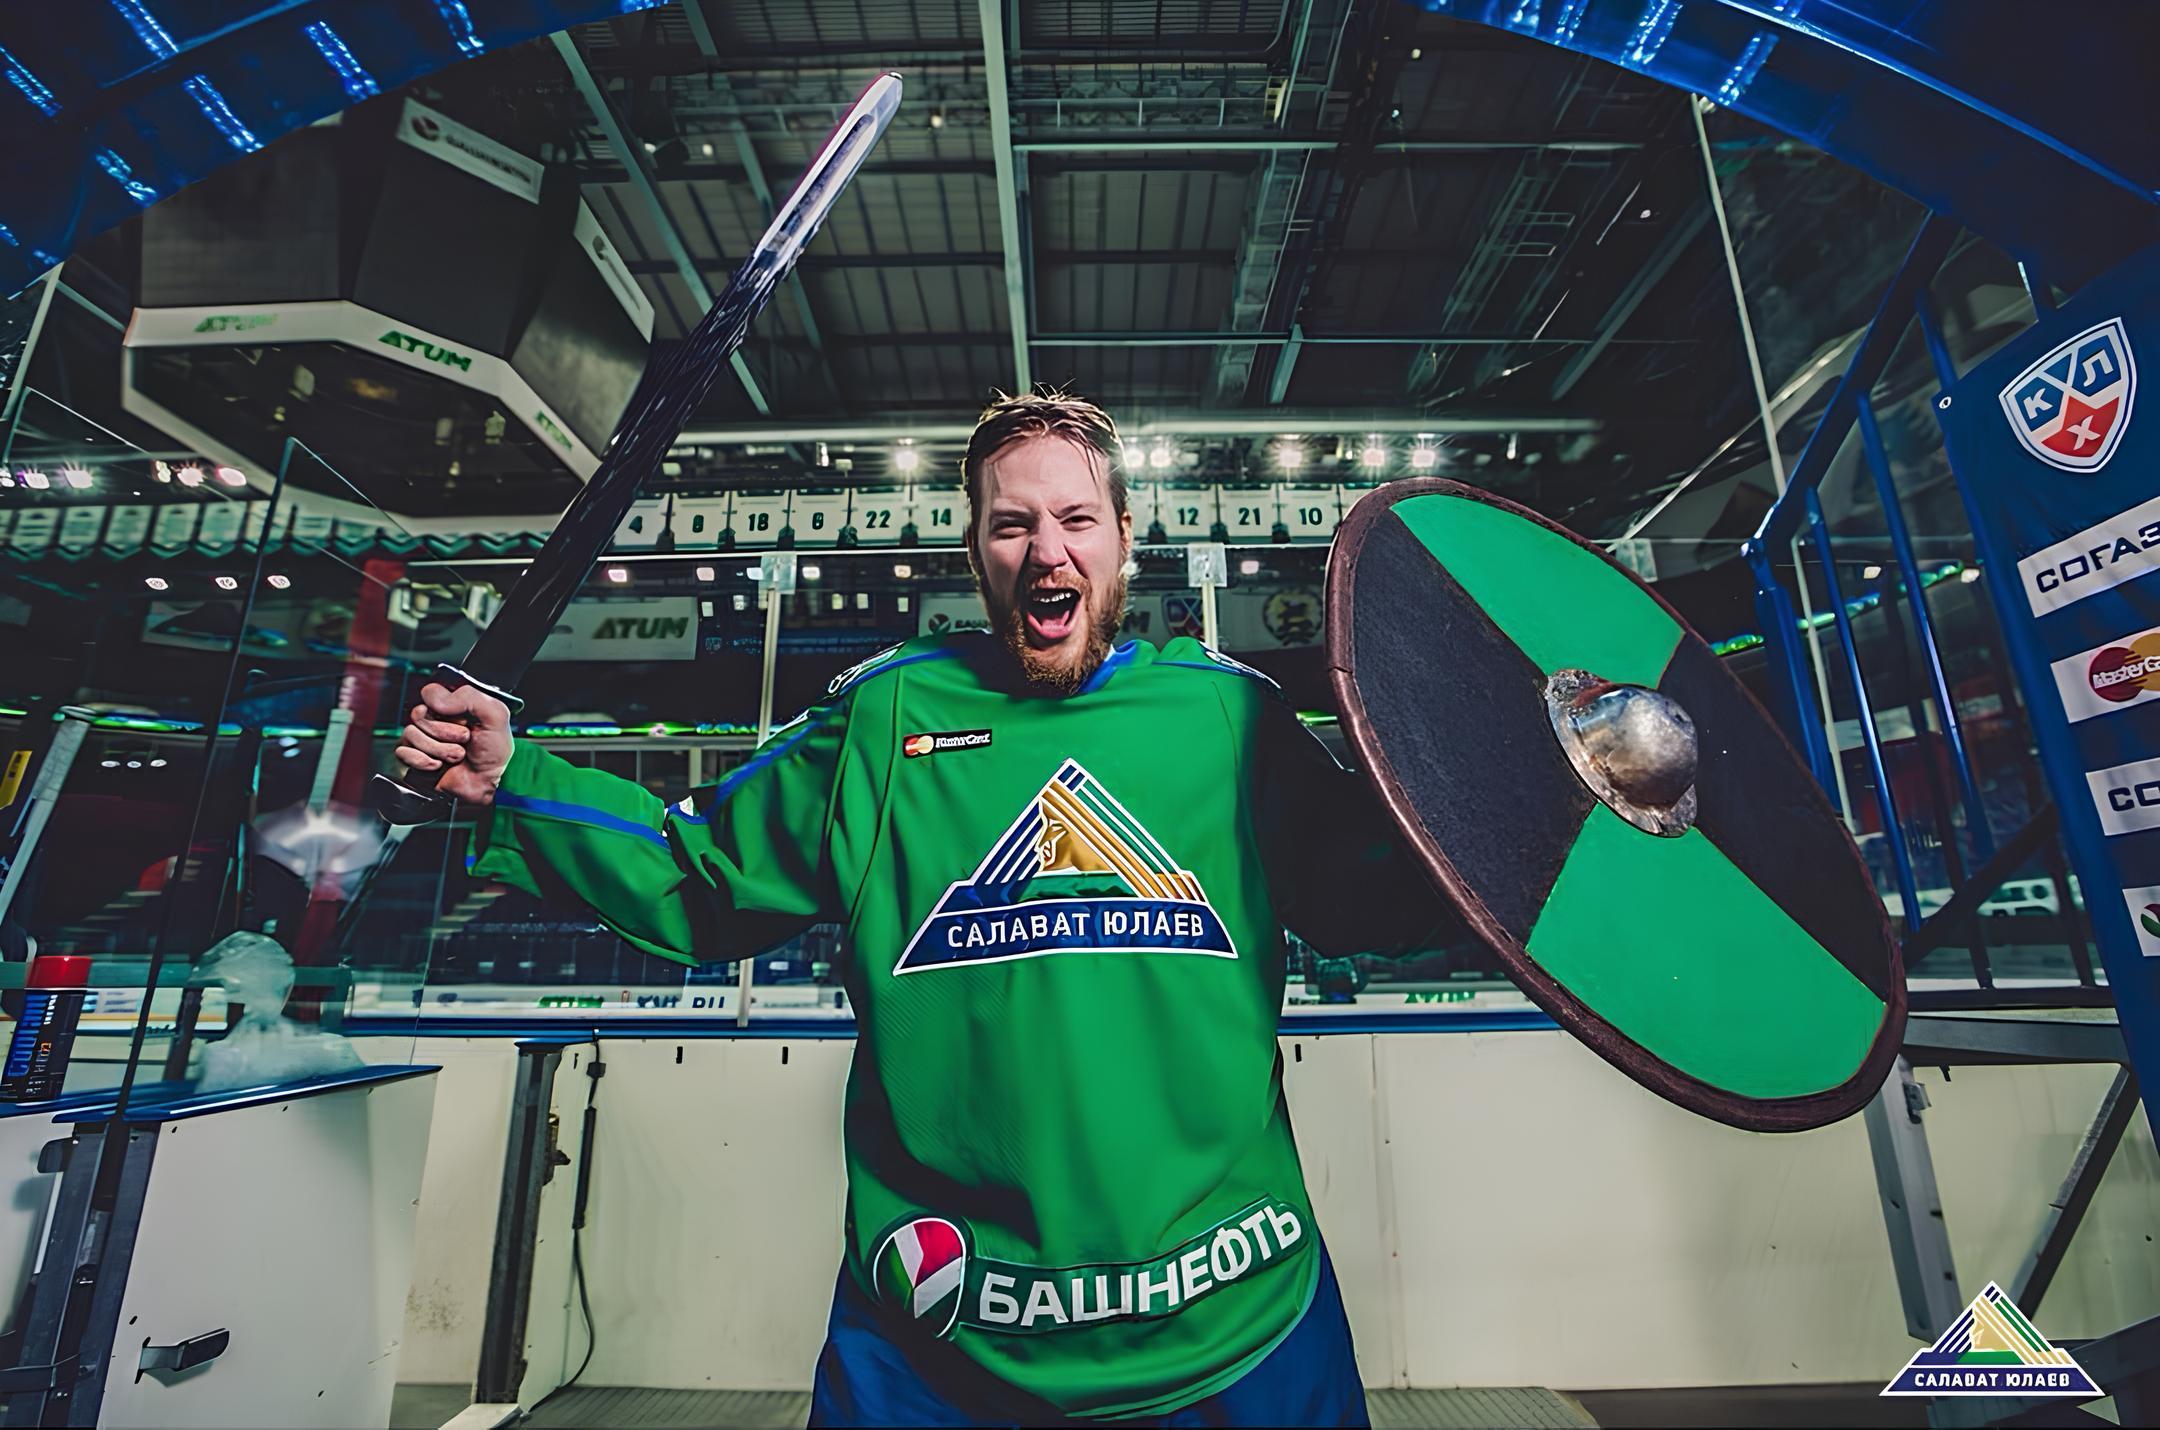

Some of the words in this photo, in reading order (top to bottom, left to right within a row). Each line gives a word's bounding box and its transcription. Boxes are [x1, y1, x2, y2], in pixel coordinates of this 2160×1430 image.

[378, 330, 473, 372] ATUM
[865, 509, 891, 529] 22
[931, 508, 952, 526] 14
[1177, 507, 1199, 526] 12
[1238, 507, 1261, 526] 21
[1299, 507, 1323, 526] 10
[592, 617, 689, 640] ATUM
[948, 911, 1090, 948] САЛАВАТ
[1104, 910, 1204, 937] ЮЛАЕВ
[979, 1205, 1302, 1327] БАШНЕФТЬ
